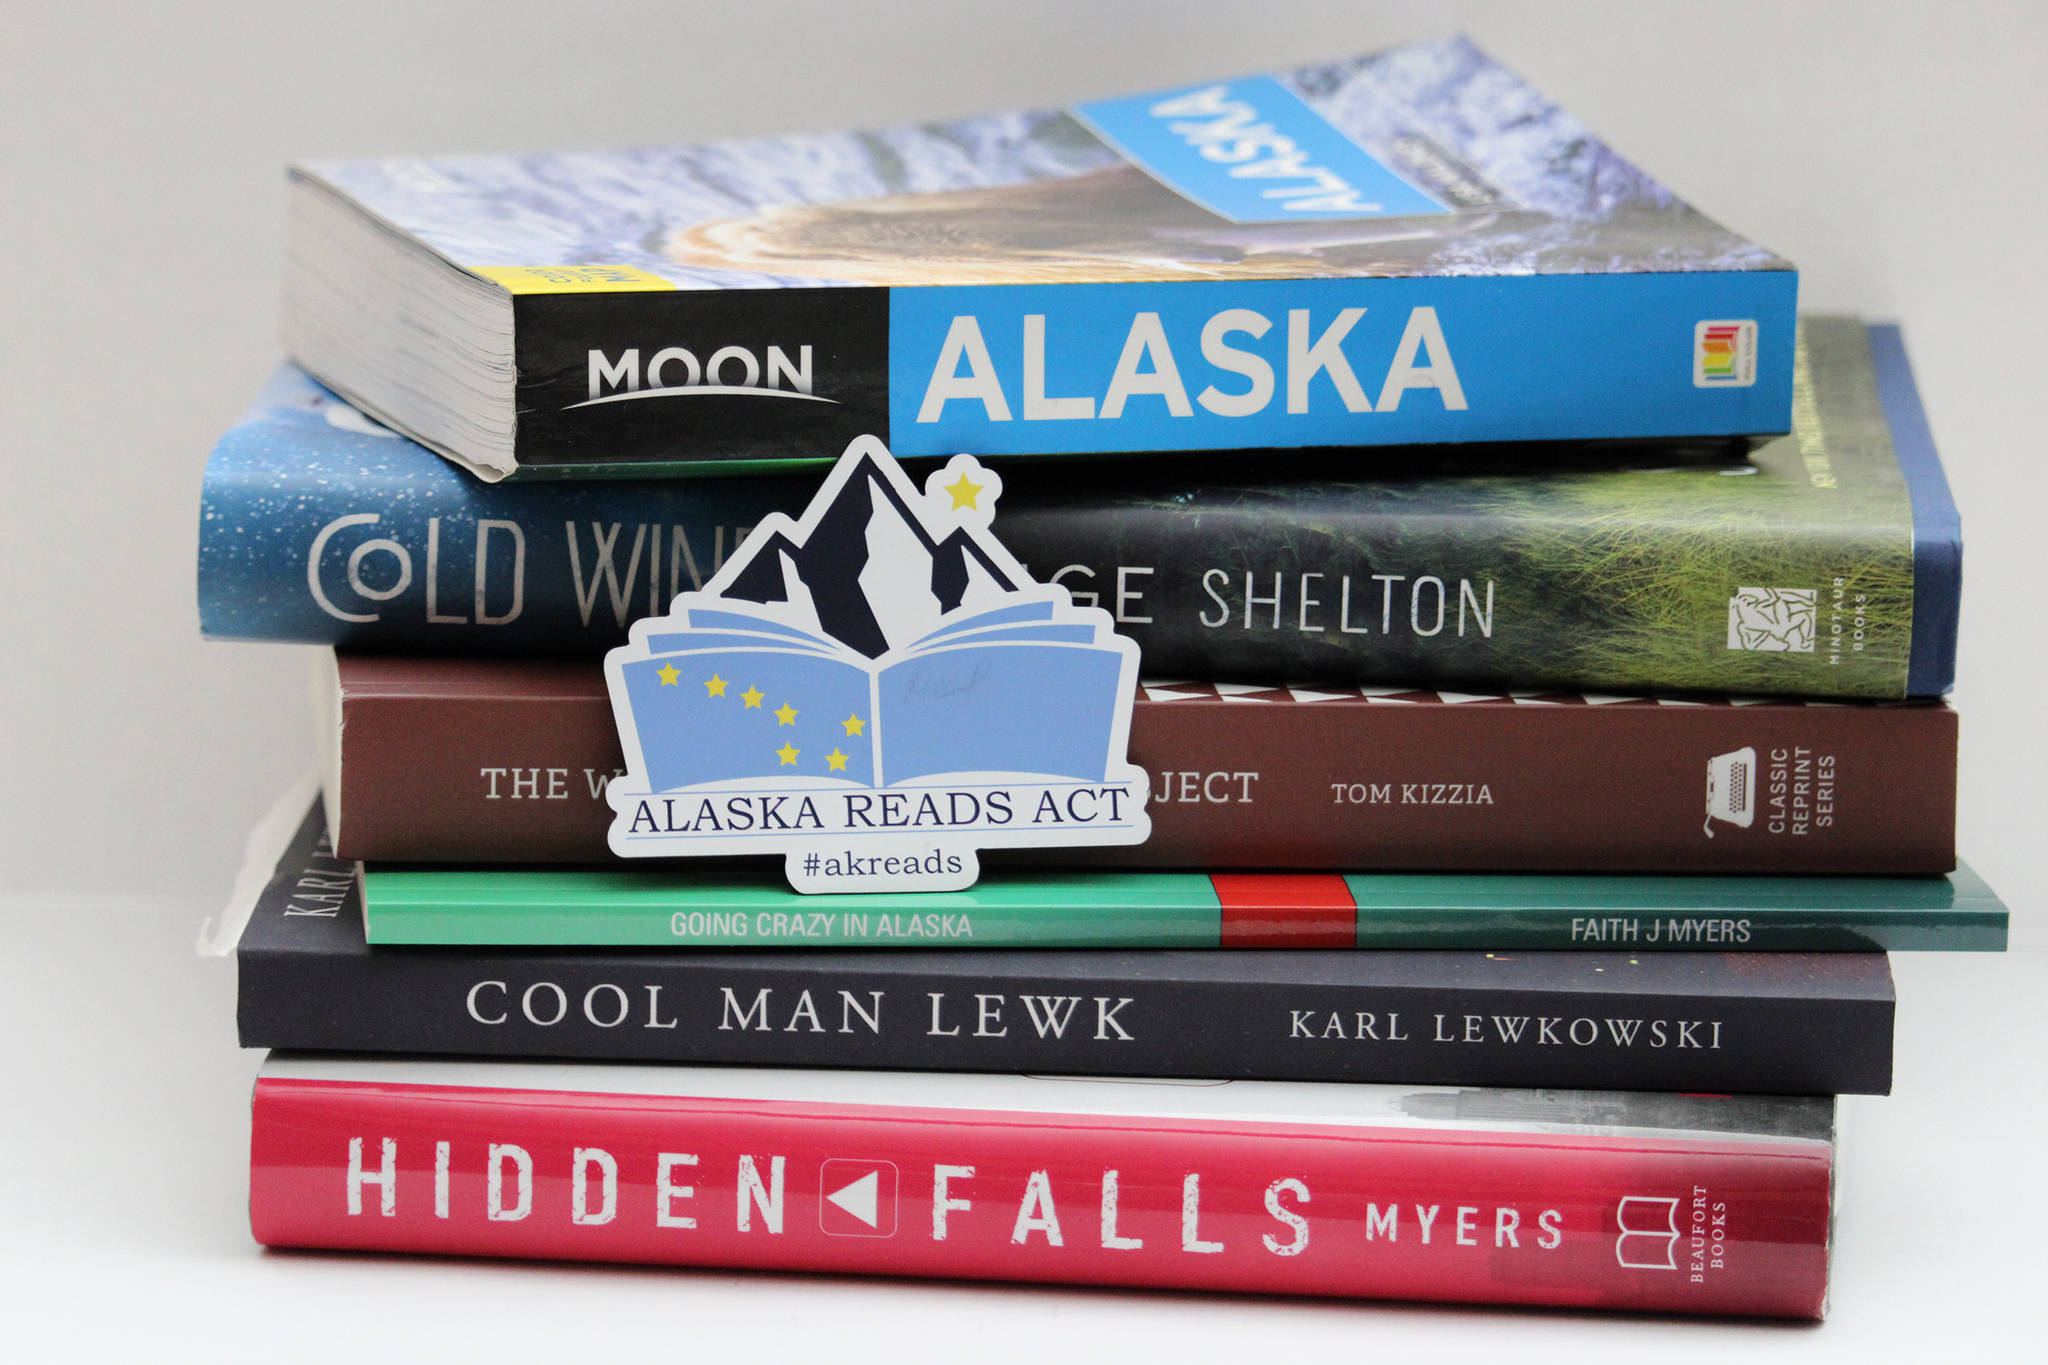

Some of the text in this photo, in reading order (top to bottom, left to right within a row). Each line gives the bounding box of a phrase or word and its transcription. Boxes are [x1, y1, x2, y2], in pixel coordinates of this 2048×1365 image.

[1150, 85, 1383, 212] ALASKA
[588, 344, 813, 395] MOON
[916, 307, 1468, 423] ALASKA
[306, 512, 526, 625] COLD
[1021, 563, 1494, 638] GE SHELTON
[1829, 577, 1844, 665] MINOTAUR
[1853, 593, 1866, 651] BOOKS
[480, 767, 568, 799] THE
[1149, 771, 1259, 803] JECT
[629, 787, 1129, 833] ALASKA READS ACT
[1331, 784, 1494, 804] TOM KIZZIA
[1768, 748, 1788, 833] CLASSIC
[1792, 747, 1811, 835] REPRINT
[1816, 755, 1835, 826] SERIES
[283, 867, 357, 917] KARL
[804, 849, 962, 876] #akreads
[670, 911, 973, 937] GOING CRAZY IN ALASKA
[1572, 918, 1751, 942] FAITH J MYERS
[466, 980, 1135, 1041] COOL MAN LEWK
[1290, 1010, 1722, 1049] KARL LEWKOWSKI
[346, 1136, 1563, 1256] HIDDEN FALLS MYERS
[1690, 1185, 1707, 1283] BEAUFORT
[1710, 1202, 1726, 1269] BOOKS
